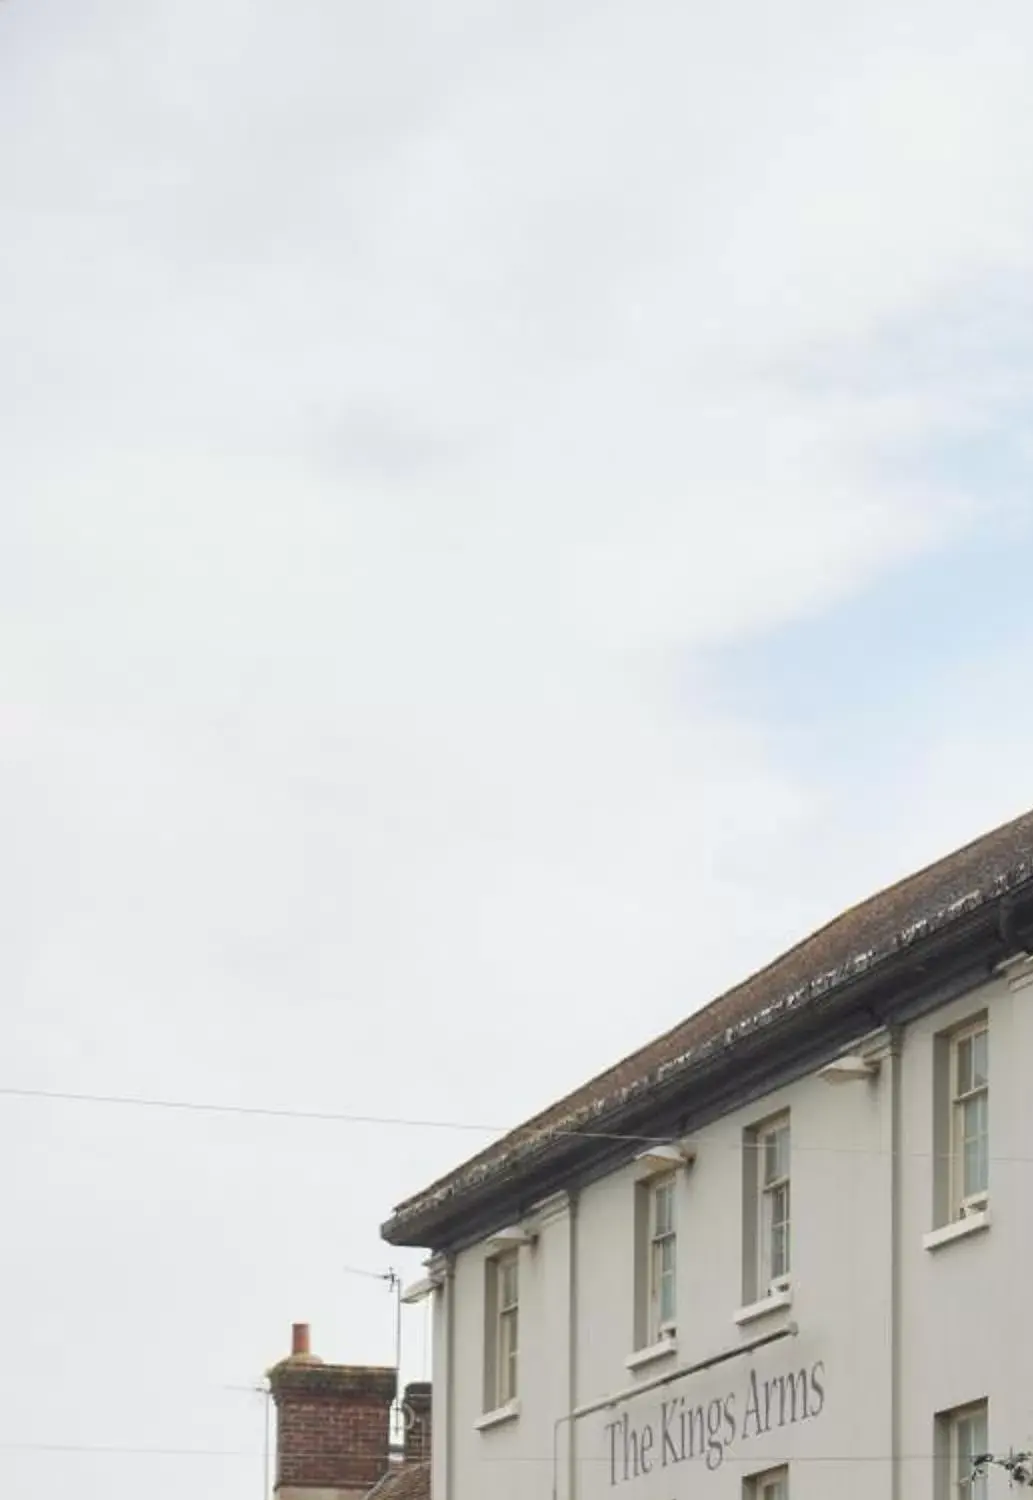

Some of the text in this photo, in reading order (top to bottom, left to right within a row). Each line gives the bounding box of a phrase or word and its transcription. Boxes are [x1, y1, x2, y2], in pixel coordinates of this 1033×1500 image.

[605, 1360, 826, 1487] The Kings Arms
